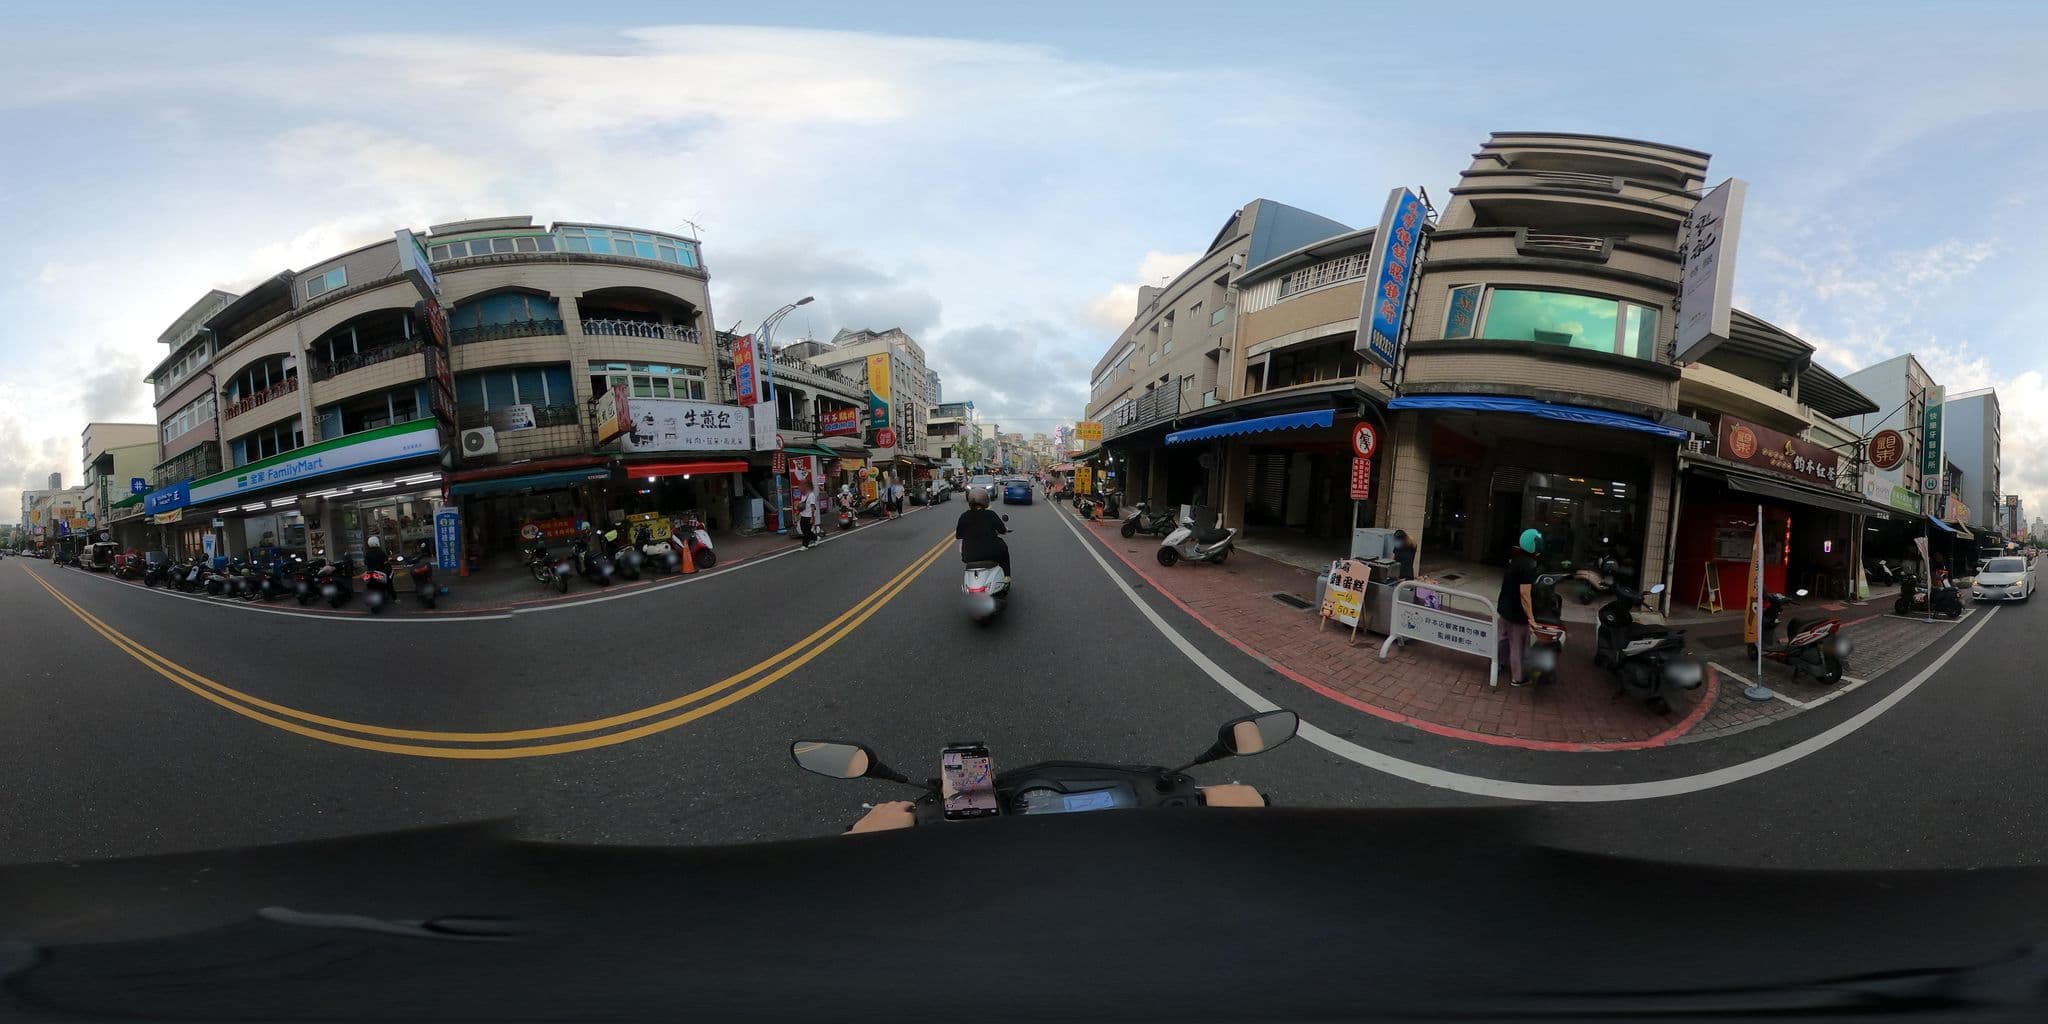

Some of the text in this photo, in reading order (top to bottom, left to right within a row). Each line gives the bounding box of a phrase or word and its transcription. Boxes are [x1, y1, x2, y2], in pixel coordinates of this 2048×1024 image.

[684, 409, 731, 429] 生煎包
[250, 457, 323, 484] 全家 FamilyMart
[1330, 572, 1365, 593] 雞蛋糕
[1337, 605, 1357, 619] 50元
